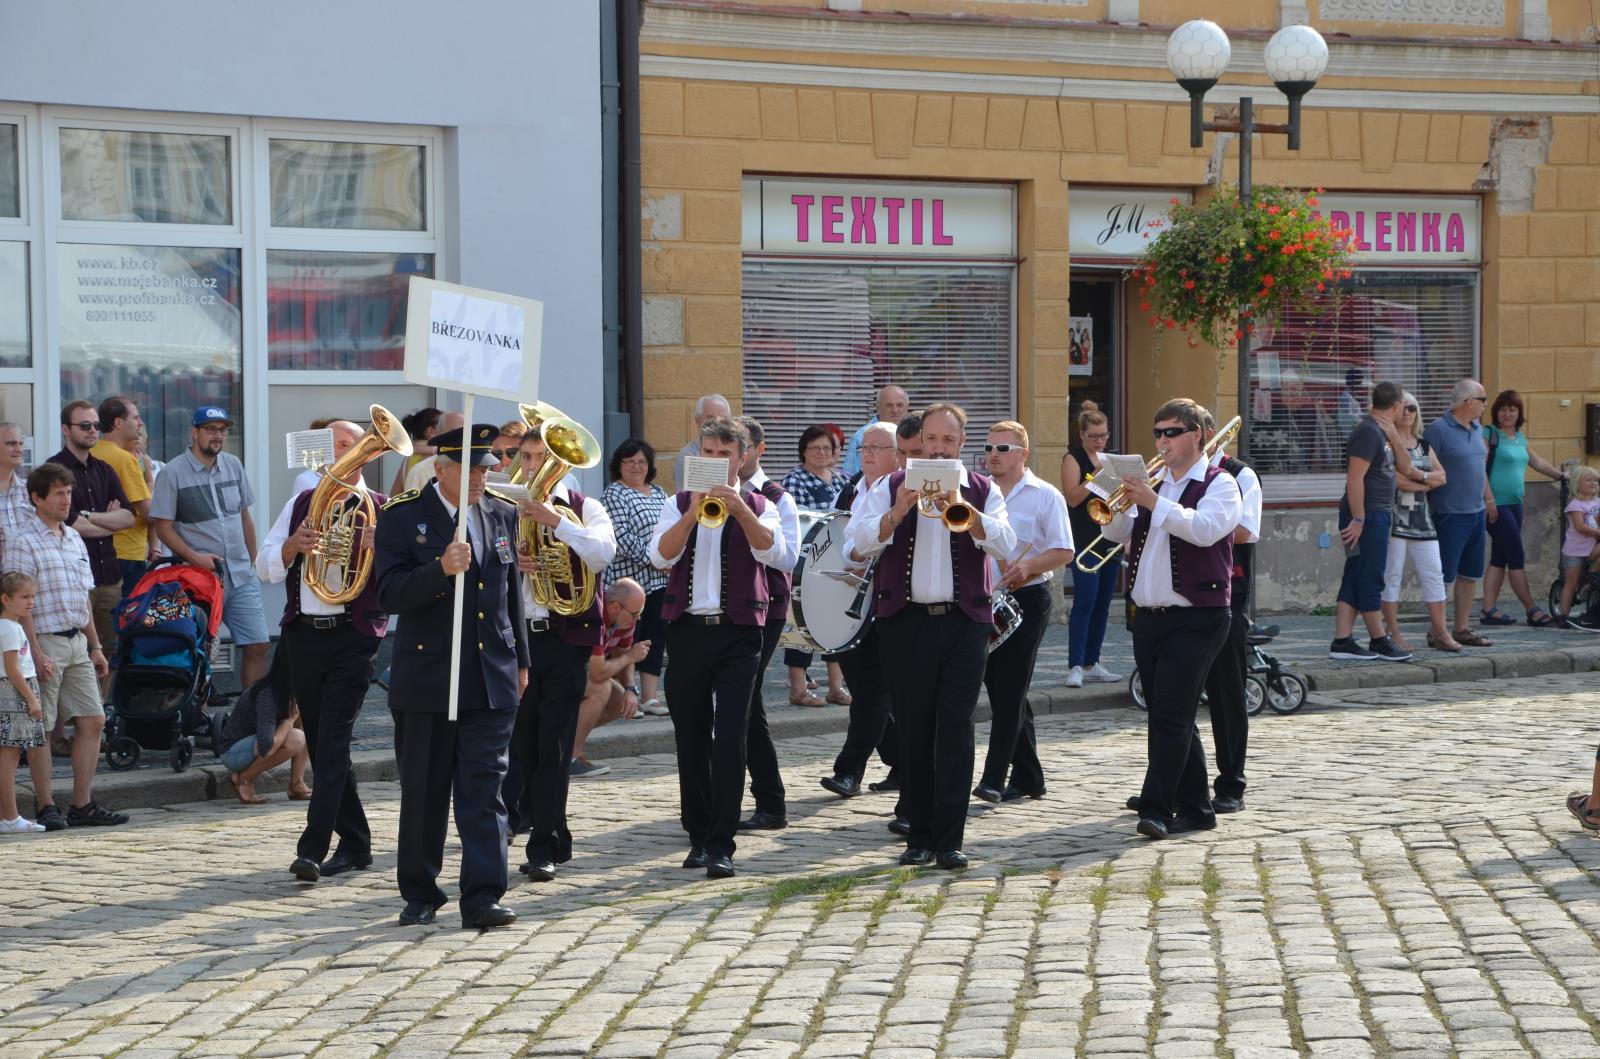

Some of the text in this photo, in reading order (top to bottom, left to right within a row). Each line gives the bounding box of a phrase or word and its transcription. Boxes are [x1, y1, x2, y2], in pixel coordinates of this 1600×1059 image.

[791, 194, 953, 246] TEXTIL
[78, 275, 218, 290] www.mojebanka.cz
[78, 291, 216, 307] www.profibanka.cz
[431, 320, 521, 350] BŘEZOVANKA
[810, 529, 833, 568] Pearl
